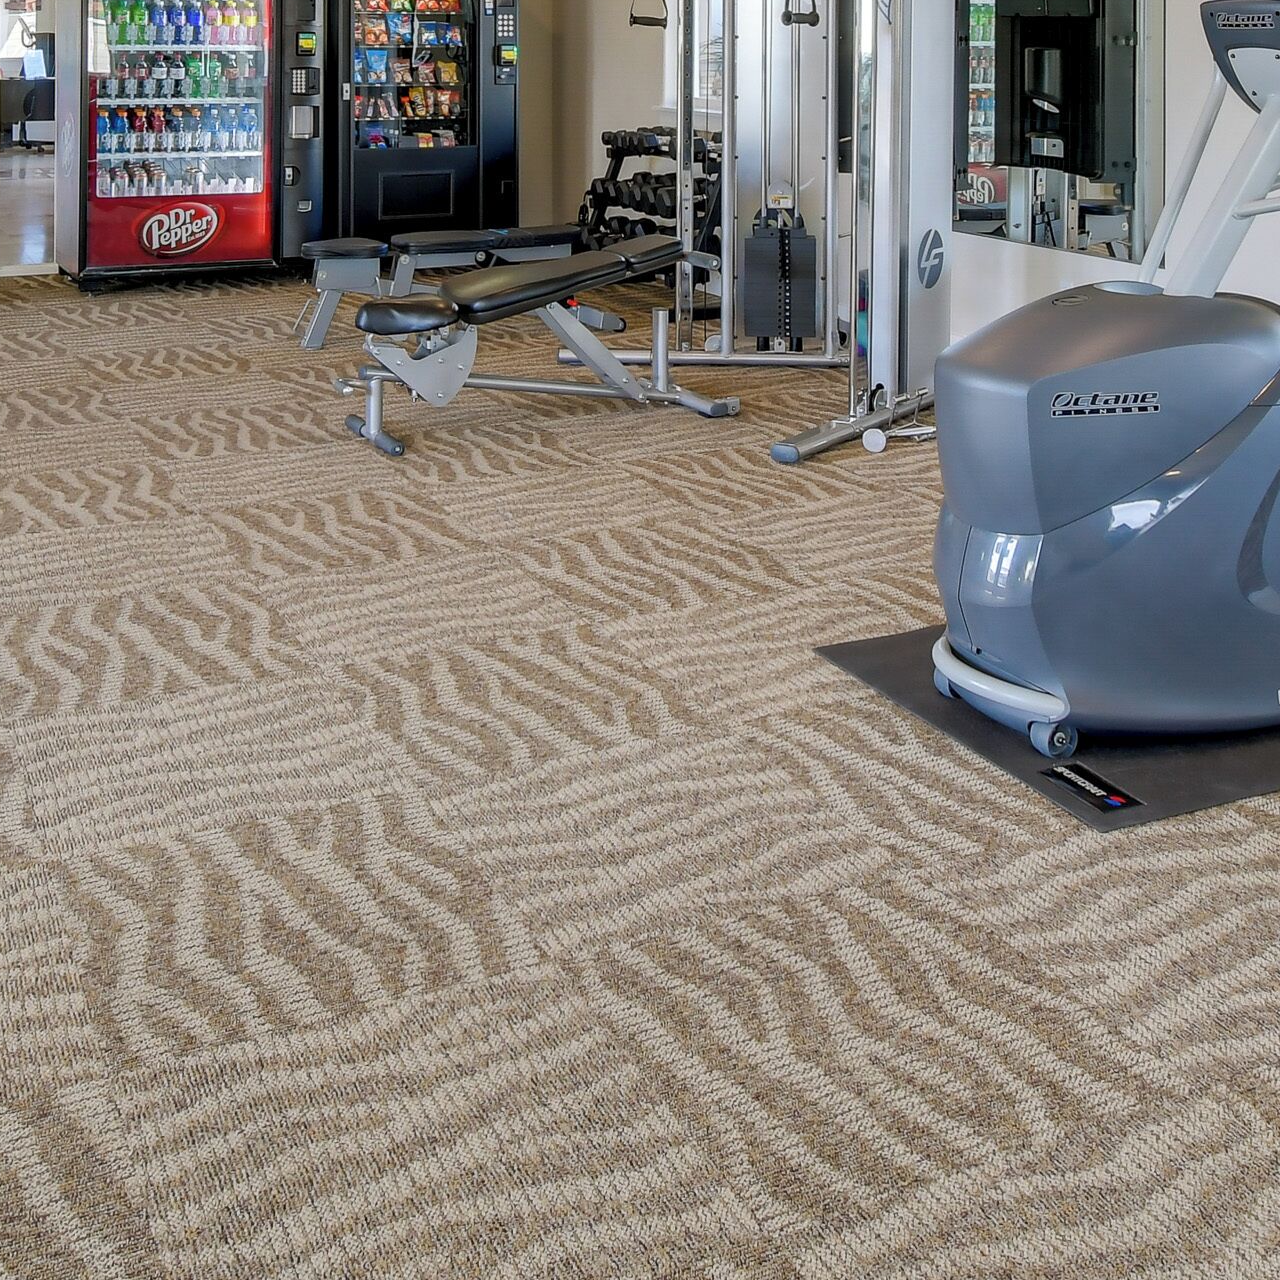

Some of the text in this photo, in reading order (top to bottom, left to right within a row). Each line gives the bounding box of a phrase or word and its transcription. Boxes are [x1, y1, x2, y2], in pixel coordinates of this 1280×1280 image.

[1216, 12, 1273, 23] Octane
[169, 208, 195, 229] Dr
[143, 213, 212, 249] Pepper
[1051, 391, 1159, 408] Octane
[1054, 406, 1156, 416] FITNESS
